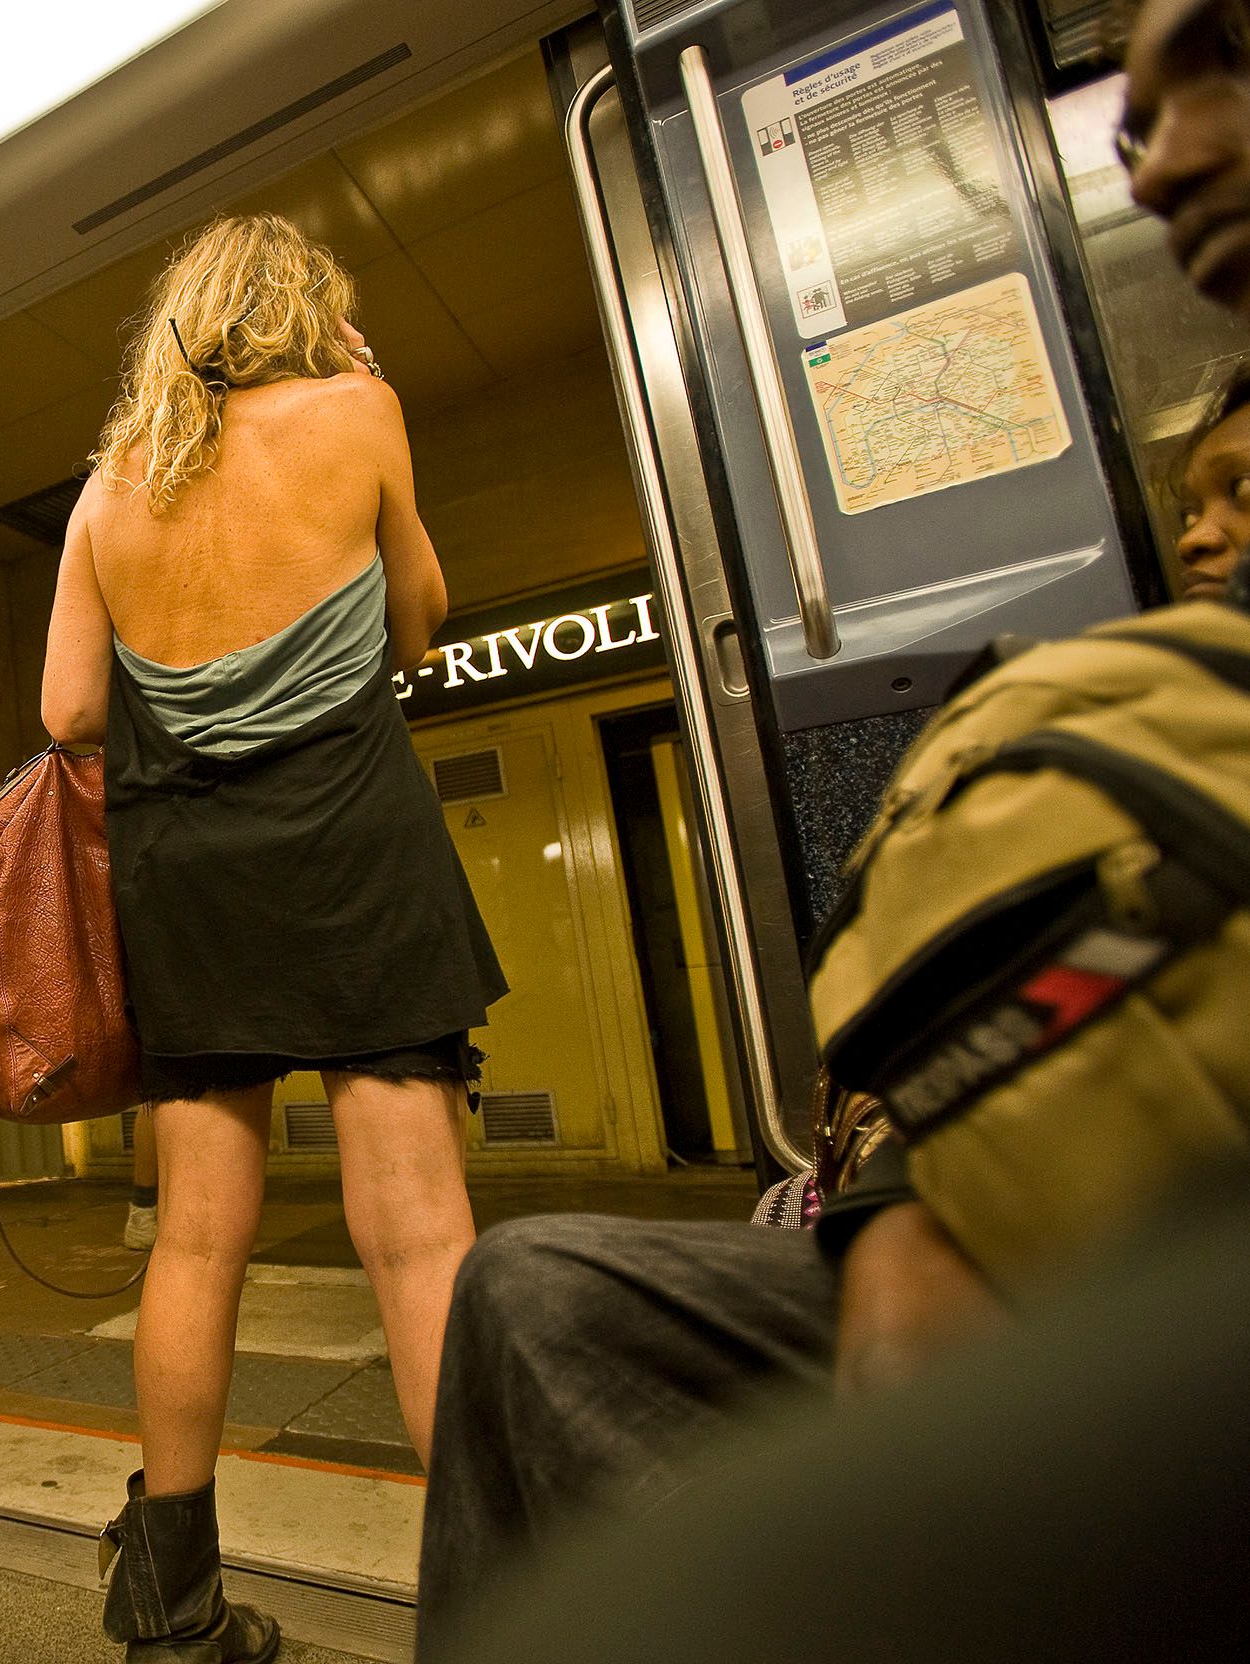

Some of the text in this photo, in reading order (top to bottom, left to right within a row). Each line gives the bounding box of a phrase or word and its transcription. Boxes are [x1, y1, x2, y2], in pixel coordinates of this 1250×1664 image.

[792, 62, 861, 98] Règles d'usage
[794, 73, 858, 106] et de sécurité
[391, 593, 661, 700] -RIVOLI
